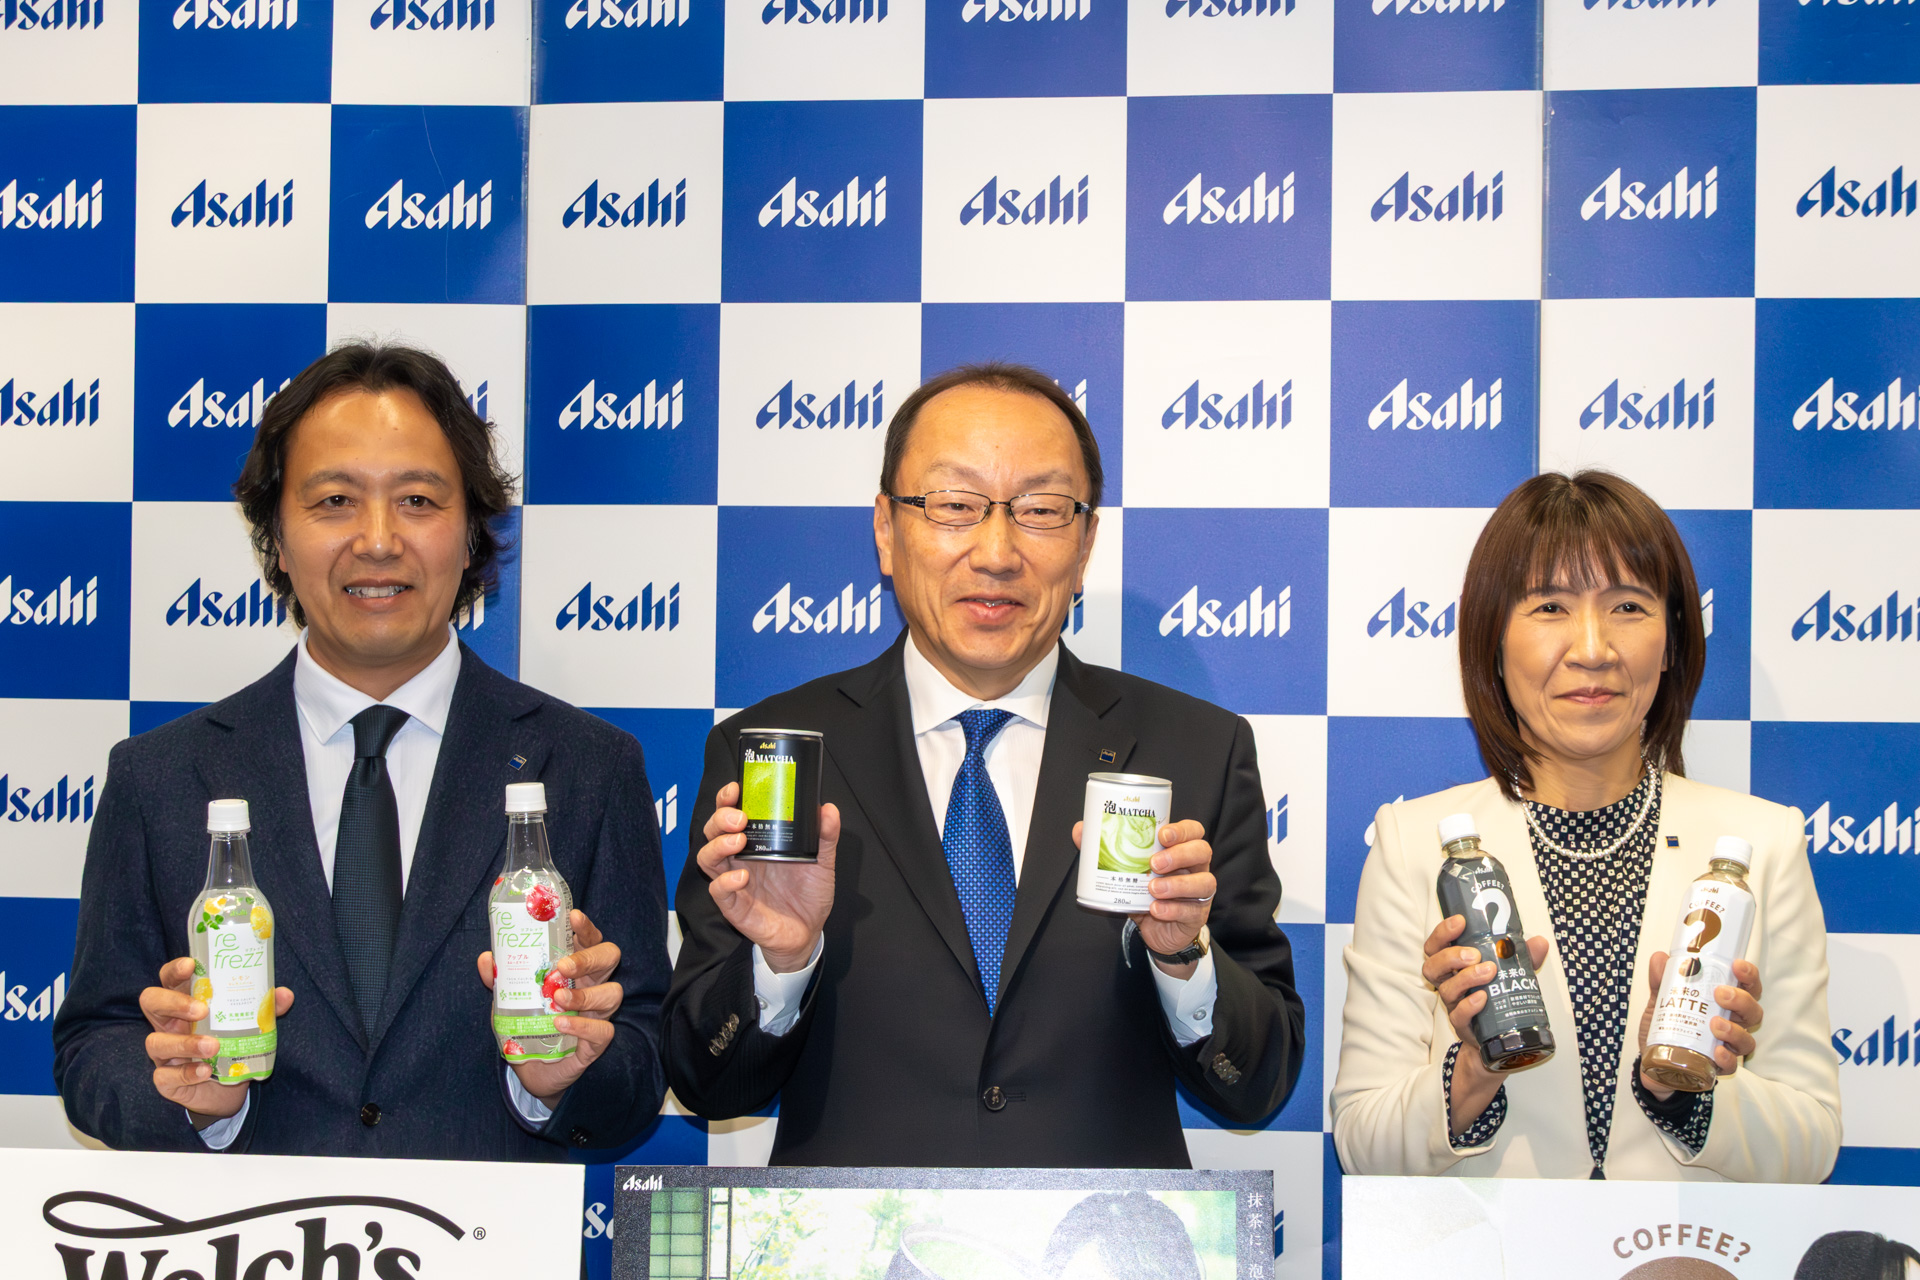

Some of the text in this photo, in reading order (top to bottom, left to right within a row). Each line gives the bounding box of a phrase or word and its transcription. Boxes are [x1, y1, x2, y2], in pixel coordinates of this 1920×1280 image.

[172, 180, 293, 227] Asahi
[365, 179, 492, 229] Asahi
[563, 179, 685, 228] Asahi
[758, 176, 886, 227] Asahi
[960, 176, 1088, 225] Asahi
[1163, 172, 1294, 224] Asahi
[1371, 171, 1502, 221] Asahi
[1580, 166, 1717, 221] Asahi
[1797, 167, 1916, 216] Asah
[559, 379, 683, 430] Asahi
[756, 380, 883, 429] Asahi
[1162, 380, 1291, 429] Asahi
[1368, 378, 1502, 430] Asahi
[1580, 379, 1714, 429] Asahi
[1792, 377, 1920, 430] Asah
[556, 582, 679, 630] Asahi
[752, 582, 881, 634] Asahi
[1159, 585, 1291, 637] Asahi
[1368, 588, 1455, 637] Asa
[0, 775, 93, 822] sahi
[215, 933, 236, 948] re
[496, 911, 512, 926] re
[496, 925, 544, 948] frezz
[214, 946, 264, 969] frezz
[1498, 967, 1526, 980] 未来の
[1488, 978, 1538, 997] BLACK
[1659, 997, 1709, 1015] LATTE
[1831, 1014, 1920, 1066] sahi
[622, 1175, 663, 1191] Asahi
[1613, 1223, 1751, 1263] COFFEE?
